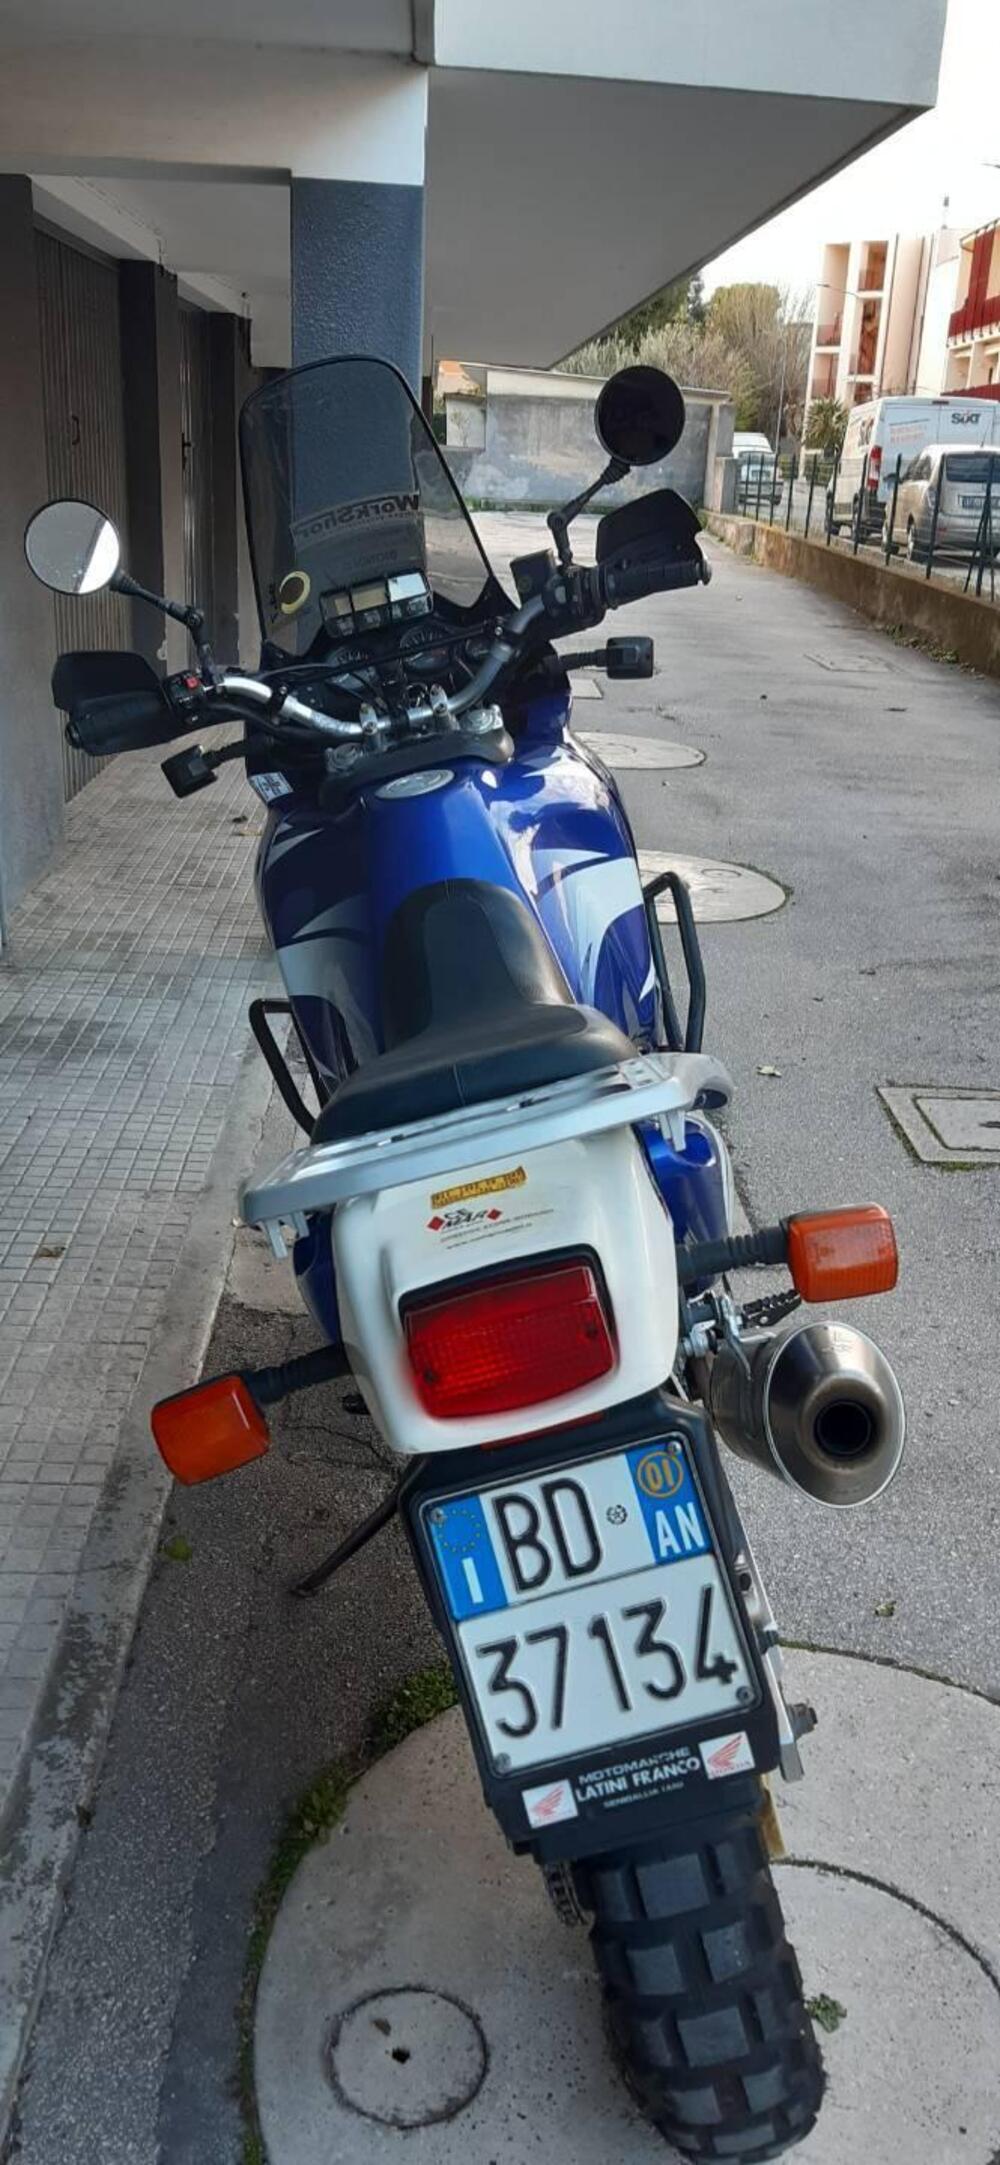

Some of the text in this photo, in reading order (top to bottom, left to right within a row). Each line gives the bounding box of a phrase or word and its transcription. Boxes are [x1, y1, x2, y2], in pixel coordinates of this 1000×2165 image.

[646, 1459, 675, 1490] 01
[491, 1476, 603, 1594] BD
[656, 1501, 705, 1558] AN
[462, 1556, 484, 1605] I
[476, 1585, 739, 1739] 37134
[575, 1757, 701, 1802] LATINI FRANCO
